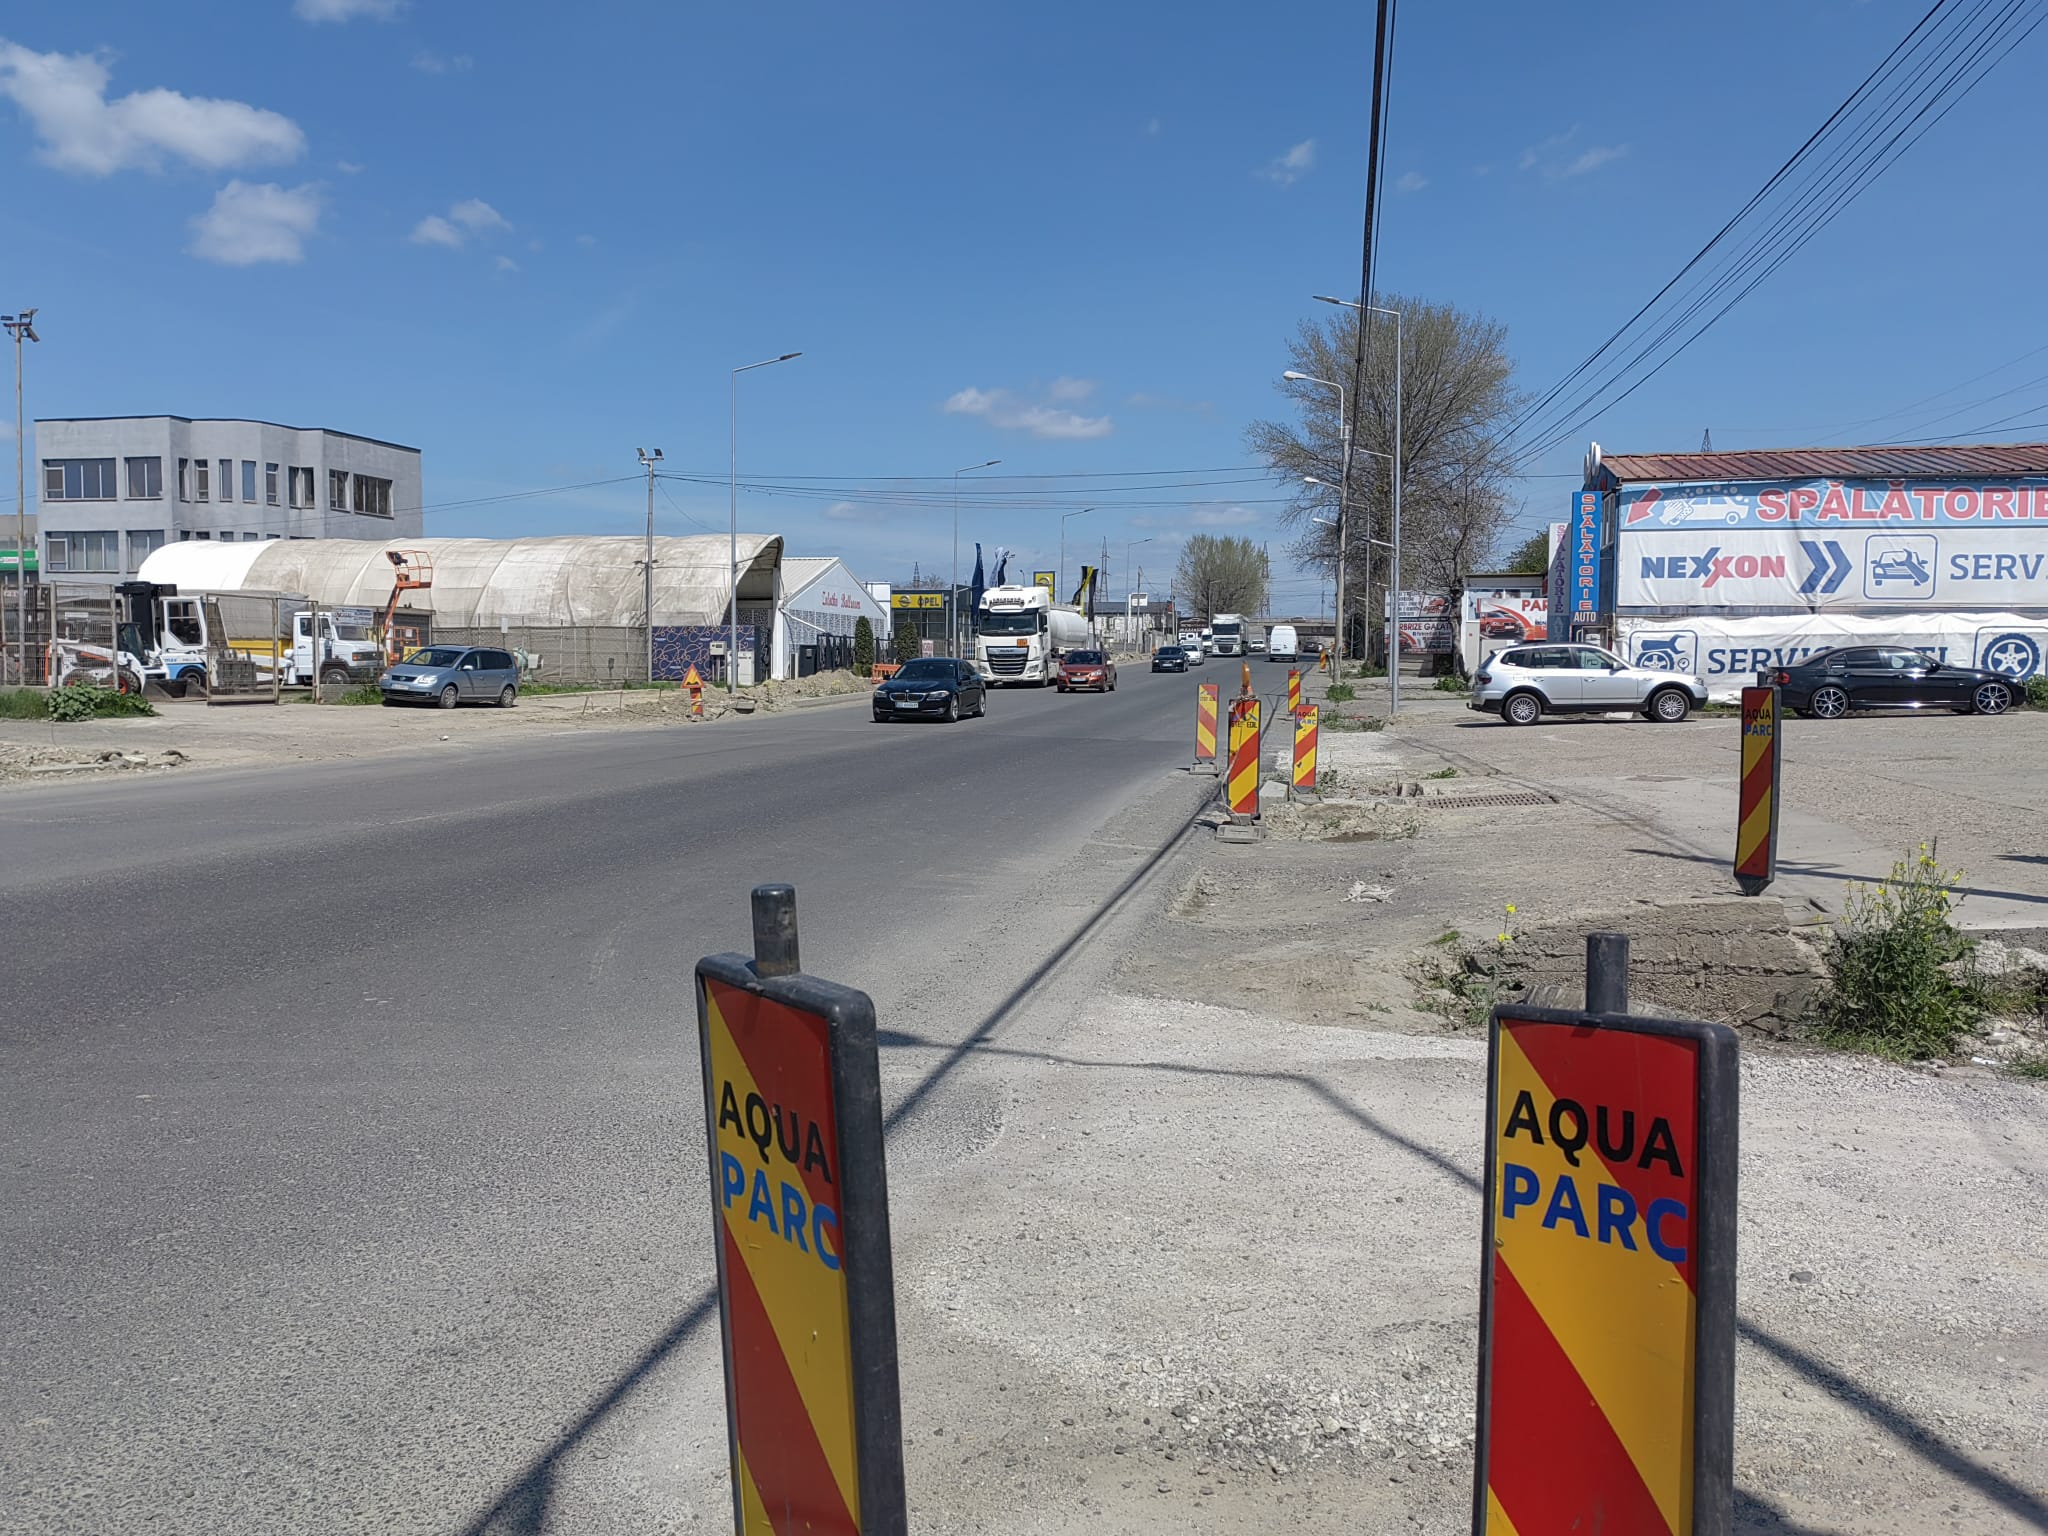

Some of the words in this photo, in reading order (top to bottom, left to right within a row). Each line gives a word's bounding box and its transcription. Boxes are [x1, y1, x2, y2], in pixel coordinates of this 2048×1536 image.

[1641, 547, 1786, 588] NEXXON
[1950, 554, 2048, 580] SERV
[1574, 611, 1596, 623] AUTO
[1297, 711, 1316, 719] AQUA
[1745, 724, 1772, 736] PARC
[1746, 709, 1771, 722] AQUA
[719, 1080, 832, 1184] AQUA
[1504, 1090, 1684, 1178] AQUA
[720, 1151, 840, 1270] PARC
[1503, 1162, 1687, 1264] PARC
